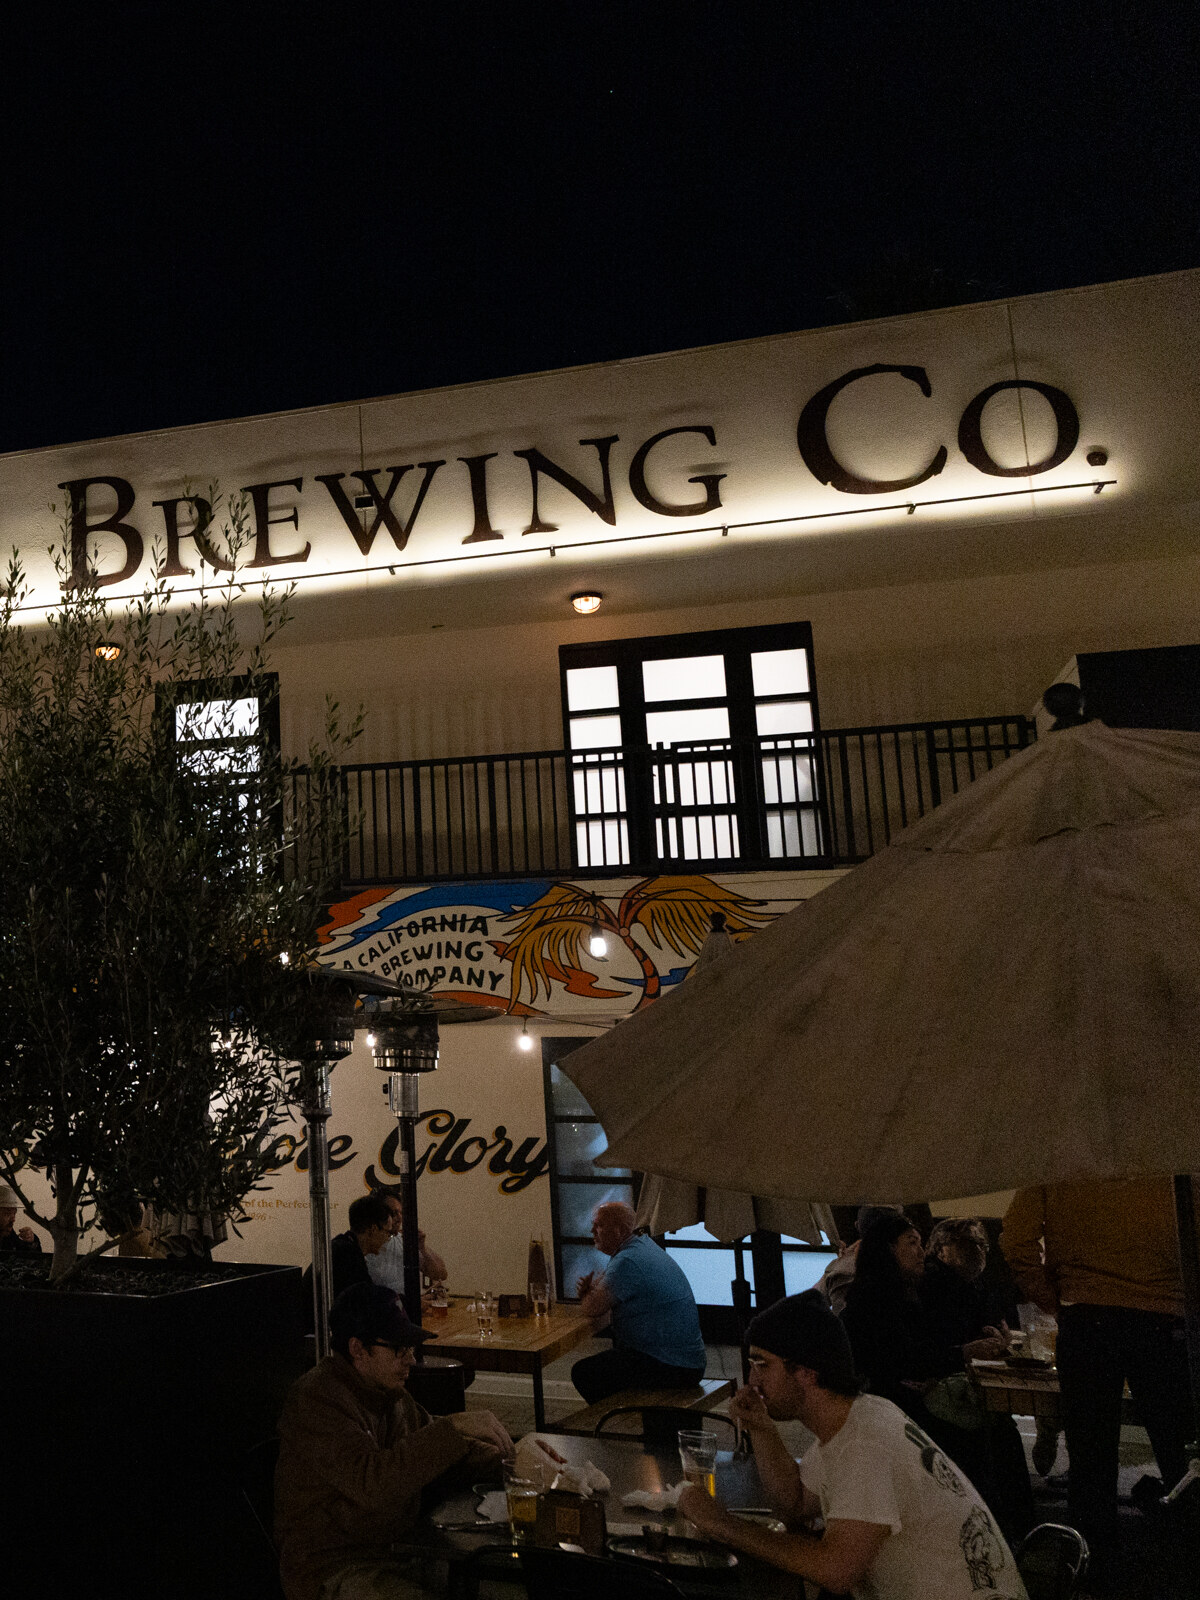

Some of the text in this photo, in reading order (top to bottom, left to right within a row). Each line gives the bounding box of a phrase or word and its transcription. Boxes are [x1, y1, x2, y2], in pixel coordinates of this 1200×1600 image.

[57, 425, 727, 592] BREWING
[358, 914, 488, 967] CALIFORNIA
[381, 940, 484, 976] BREWING
[364, 1109, 551, 1196] Glory
[257, 1200, 274, 1209] the
[275, 1199, 311, 1210] Perfec
